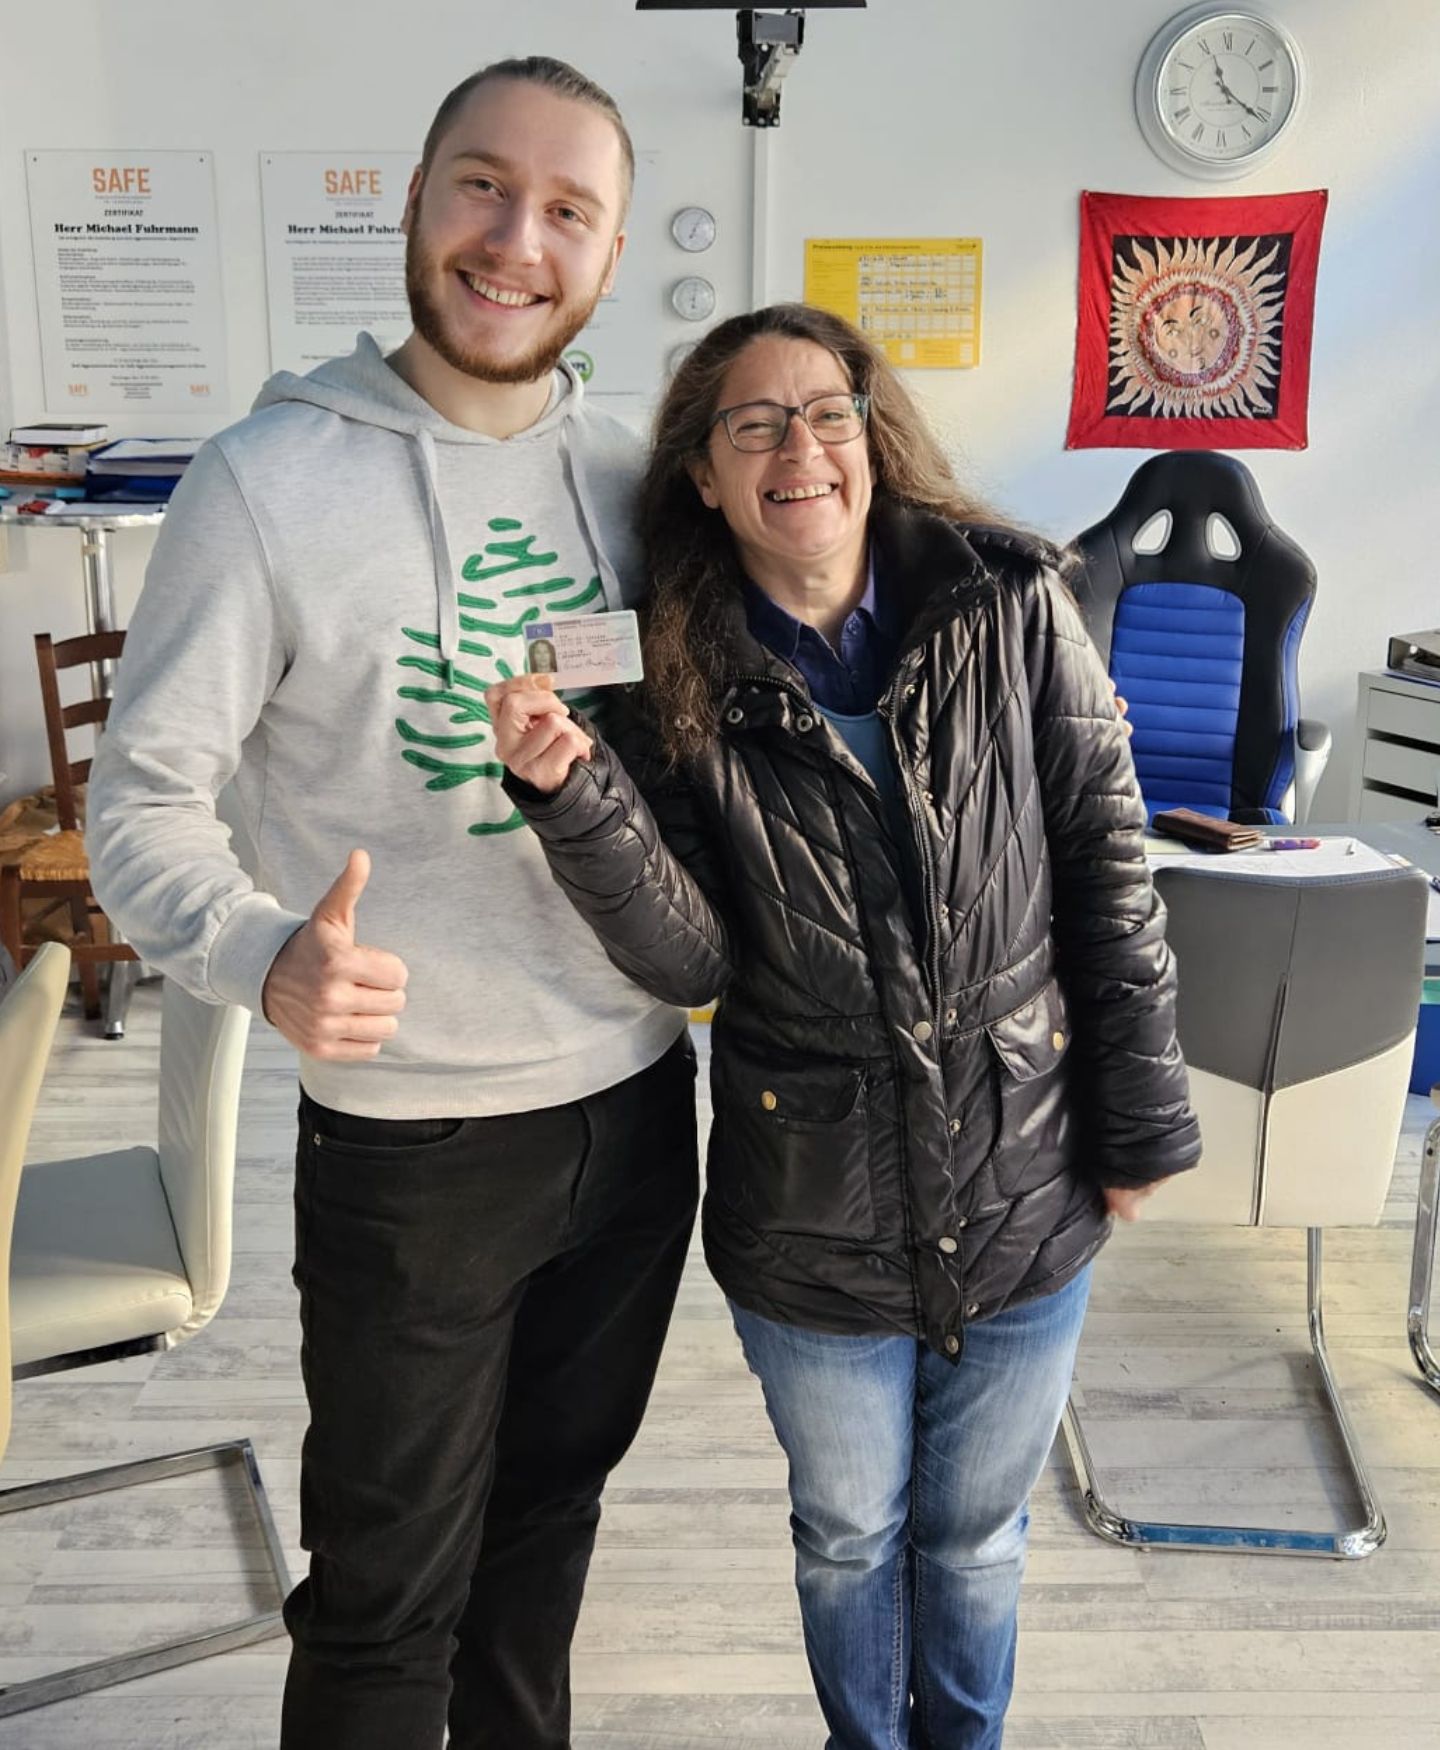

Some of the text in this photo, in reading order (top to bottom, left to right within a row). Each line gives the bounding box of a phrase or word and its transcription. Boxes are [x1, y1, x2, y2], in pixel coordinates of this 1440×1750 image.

[92, 167, 151, 193] SAFE
[324, 169, 382, 195] SAFE
[54, 223, 199, 234] Herr Michael Fuhrmann
[288, 224, 315, 234] Herr
[319, 224, 364, 234] Michael
